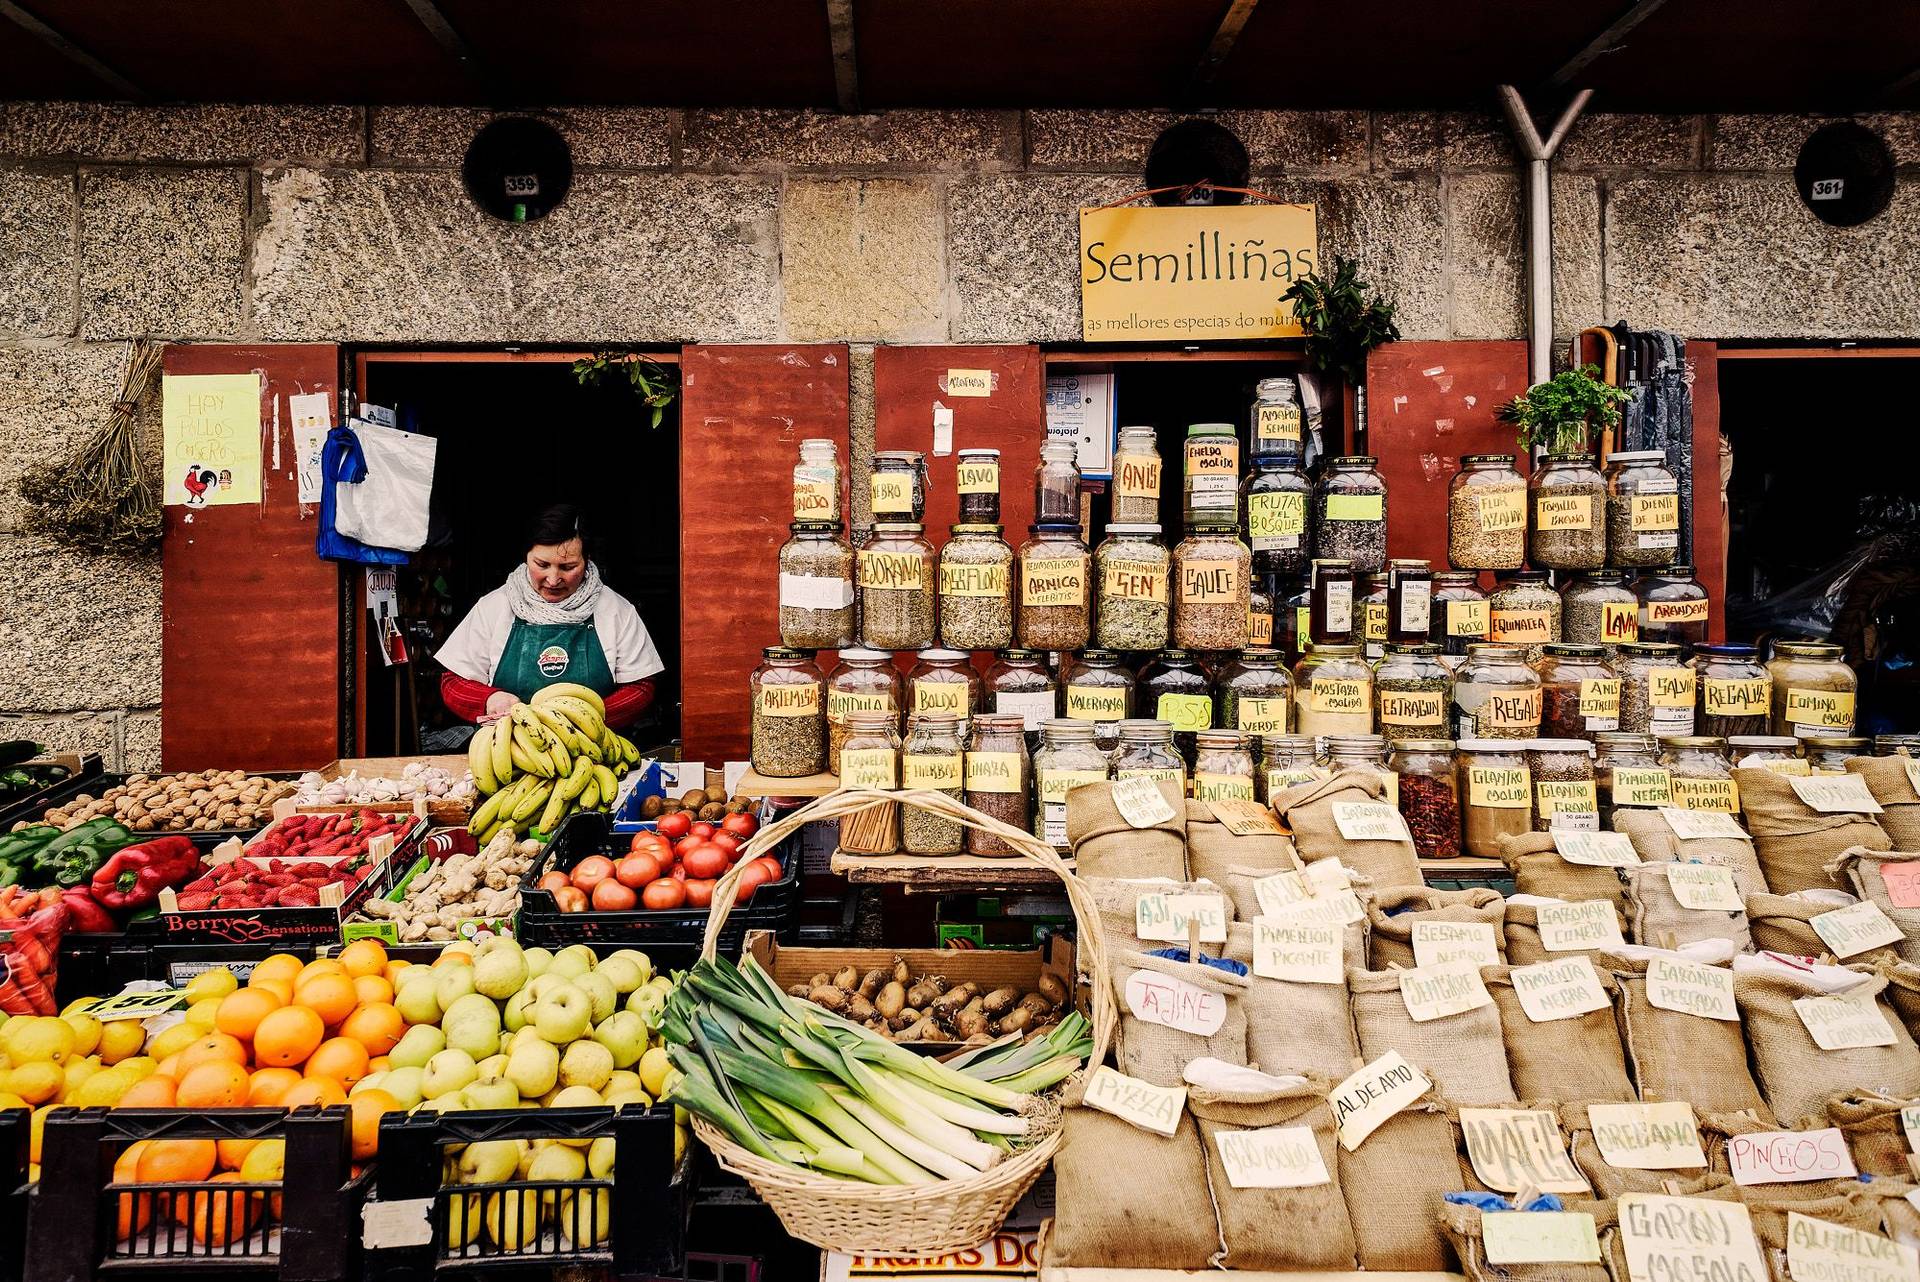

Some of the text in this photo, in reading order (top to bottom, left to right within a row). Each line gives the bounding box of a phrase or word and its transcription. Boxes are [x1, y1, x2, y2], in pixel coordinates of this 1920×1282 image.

[1816, 181, 1840, 194] 361
[1087, 230, 1313, 284] Semilliñas
[1088, 318, 1102, 330] as
[1107, 313, 1170, 329] mellores
[1174, 314, 1231, 332] especias
[1235, 311, 1255, 327] do
[1122, 462, 1158, 491] ANIS
[1251, 495, 1302, 511] FRUTAS
[1250, 515, 1299, 532] BOSQUE
[1028, 575, 1080, 596] ARNICA
[1185, 569, 1236, 599] SAUCE
[1491, 617, 1547, 635] EQUINACEA
[764, 688, 818, 709] ARTEMISA
[920, 690, 958, 710] BOLDO
[1069, 694, 1124, 712] VALERIANA
[1788, 693, 1836, 712] COMINO
[1243, 719, 1280, 732] VERDE
[1618, 771, 1667, 787] PIMIENTA
[1674, 780, 1731, 795] PIMIENTA
[1686, 796, 1732, 812] BLANCA
[165, 915, 234, 935] Berry
[263, 923, 334, 936] Sensations
